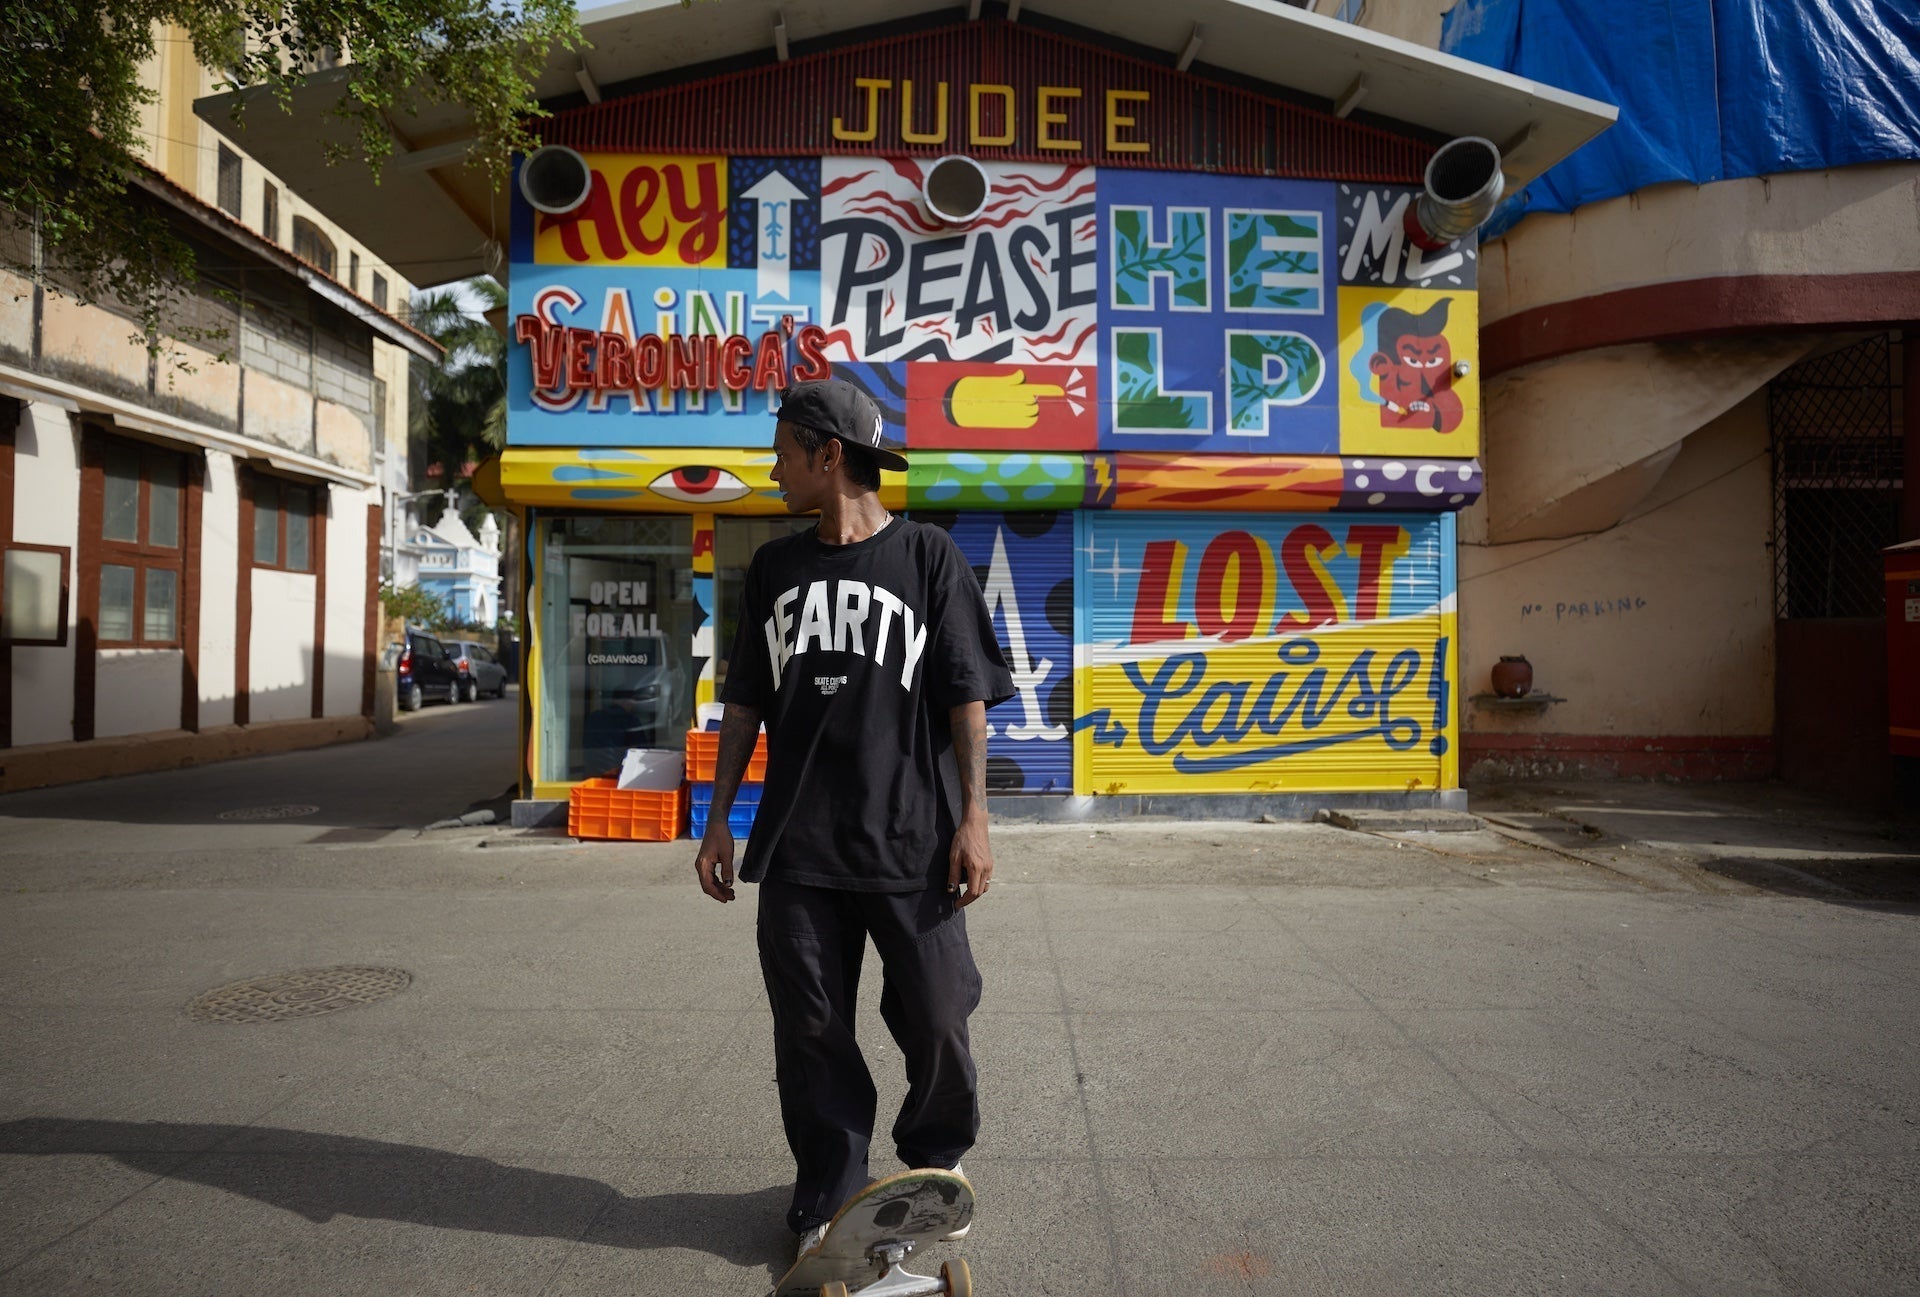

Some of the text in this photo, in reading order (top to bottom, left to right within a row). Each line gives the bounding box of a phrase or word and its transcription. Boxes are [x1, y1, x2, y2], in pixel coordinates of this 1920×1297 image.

[832, 78, 1150, 152] JUDEE
[819, 203, 1096, 357] PLEASE
[515, 313, 832, 391] VERONICA'S
[590, 581, 647, 605] OPEN
[1130, 524, 1410, 644] LOST
[1555, 597, 1647, 621] PARKING
[573, 613, 662, 637] FOR ALL
[587, 654, 648, 665] (CRAVINGS)
[764, 579, 928, 692] HEARTY
